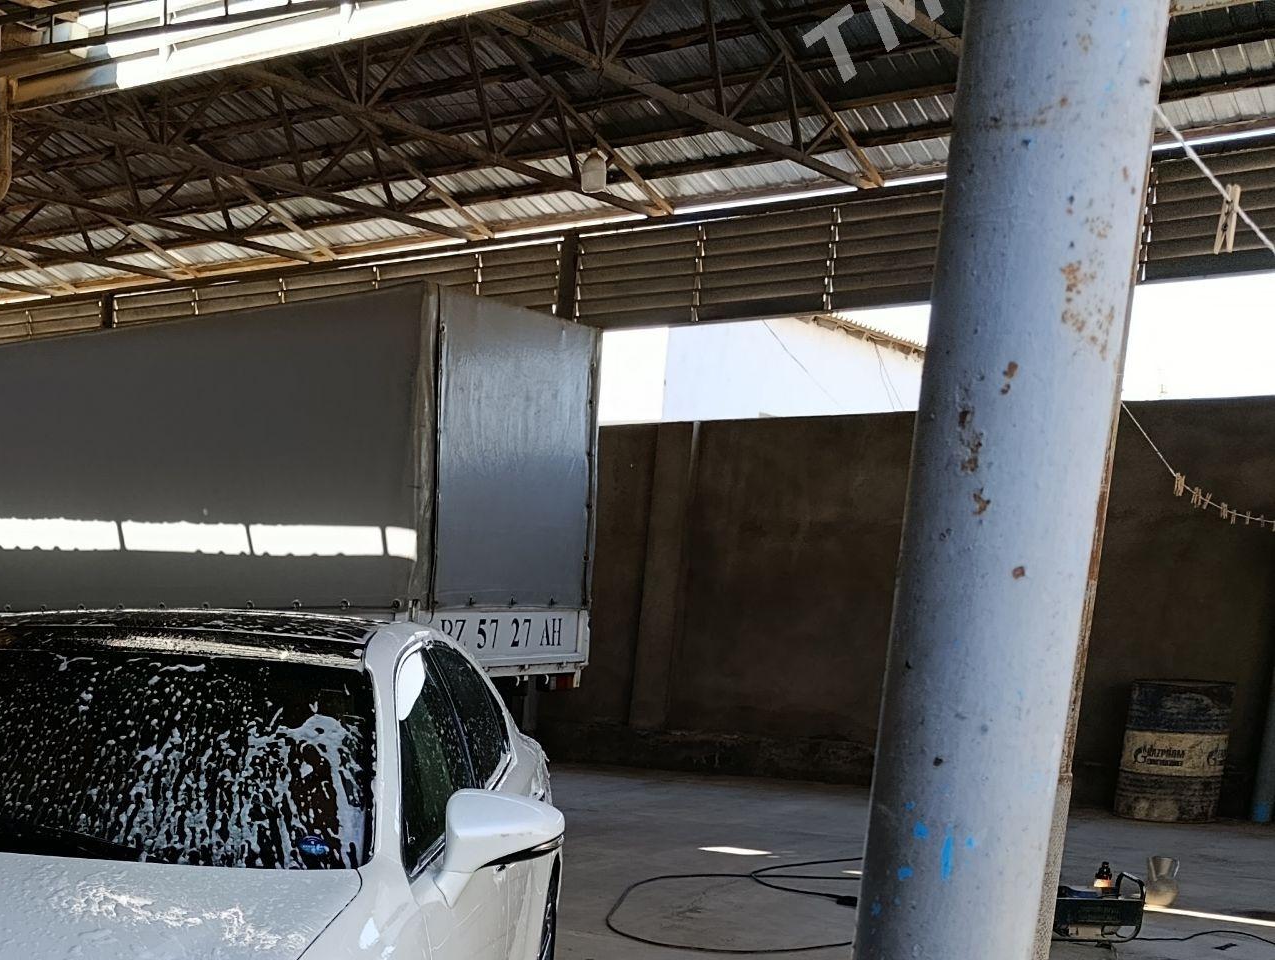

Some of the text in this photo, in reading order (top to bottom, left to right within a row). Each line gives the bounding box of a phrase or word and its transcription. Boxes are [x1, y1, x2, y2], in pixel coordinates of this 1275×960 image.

[476, 618, 499, 649] 57
[510, 617, 532, 648] 27
[539, 617, 563, 646] AH
